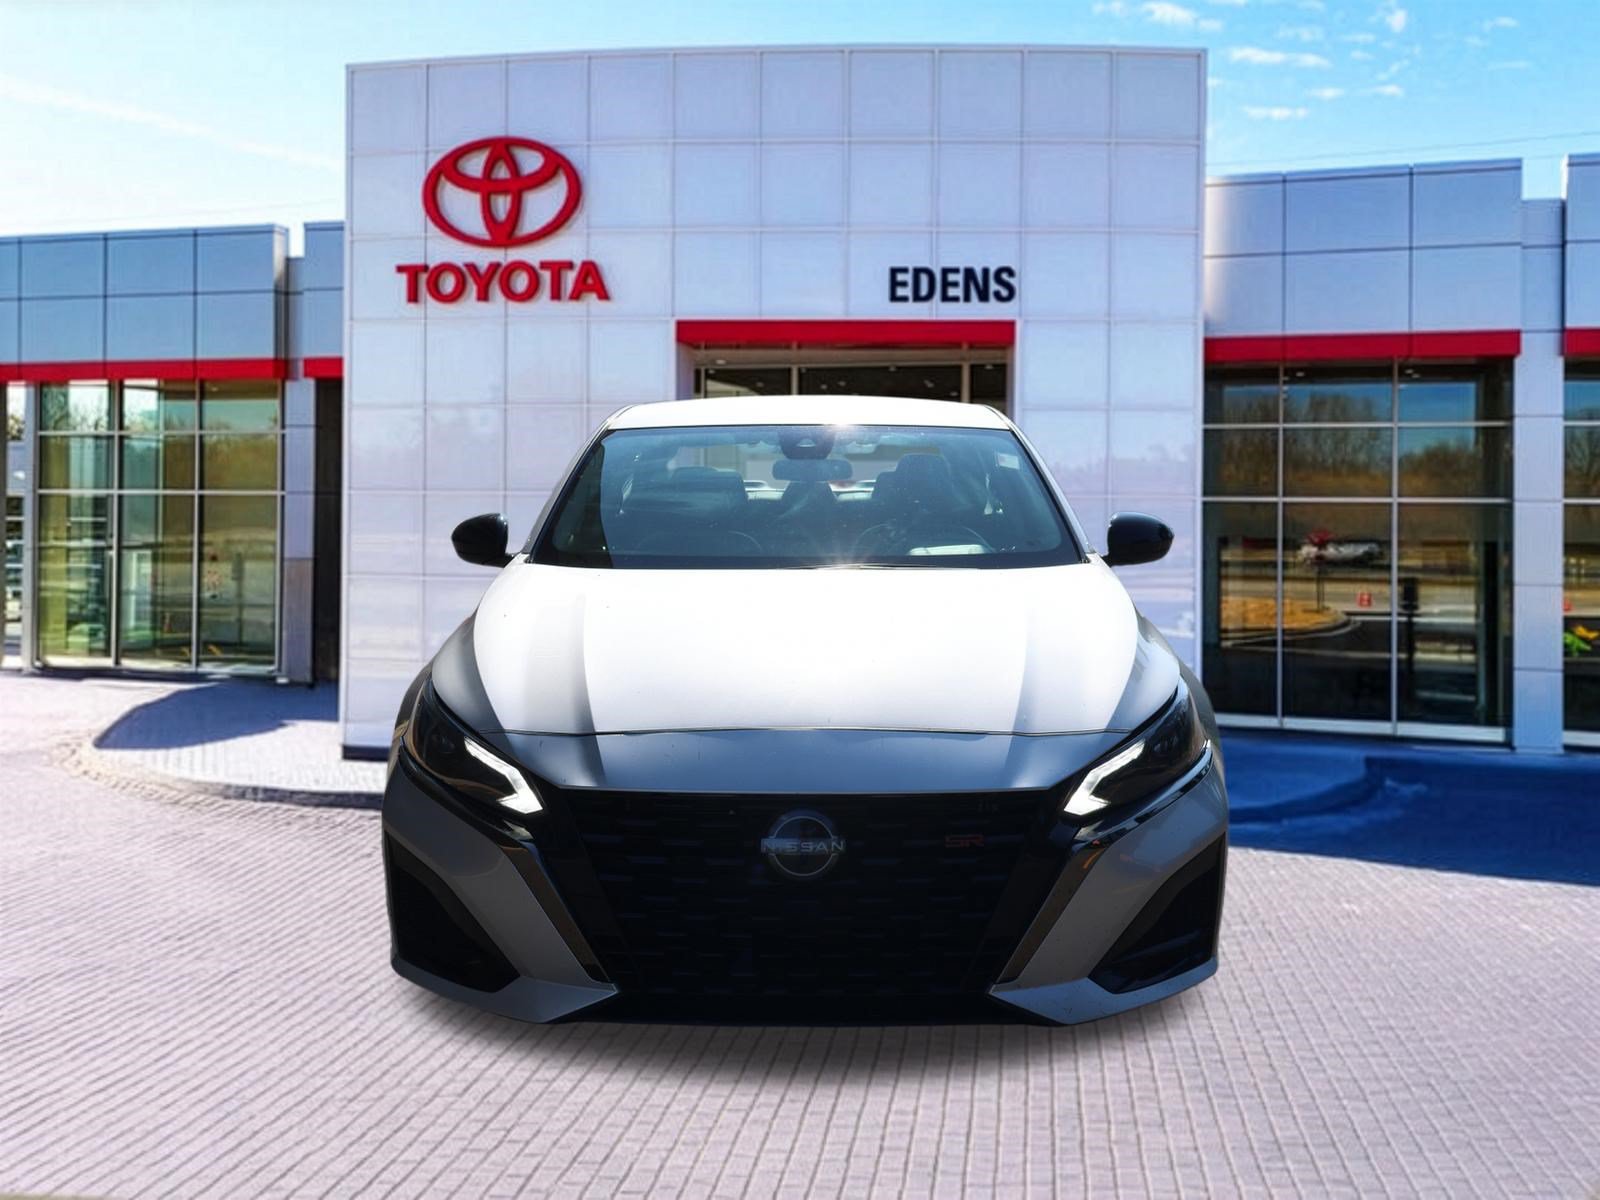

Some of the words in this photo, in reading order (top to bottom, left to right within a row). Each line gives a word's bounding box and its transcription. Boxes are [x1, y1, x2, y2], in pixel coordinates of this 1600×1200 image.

[396, 260, 610, 303] TOYOTA
[889, 266, 1016, 303] EDENS
[761, 839, 846, 854] NISSAN
[944, 834, 984, 848] SR
